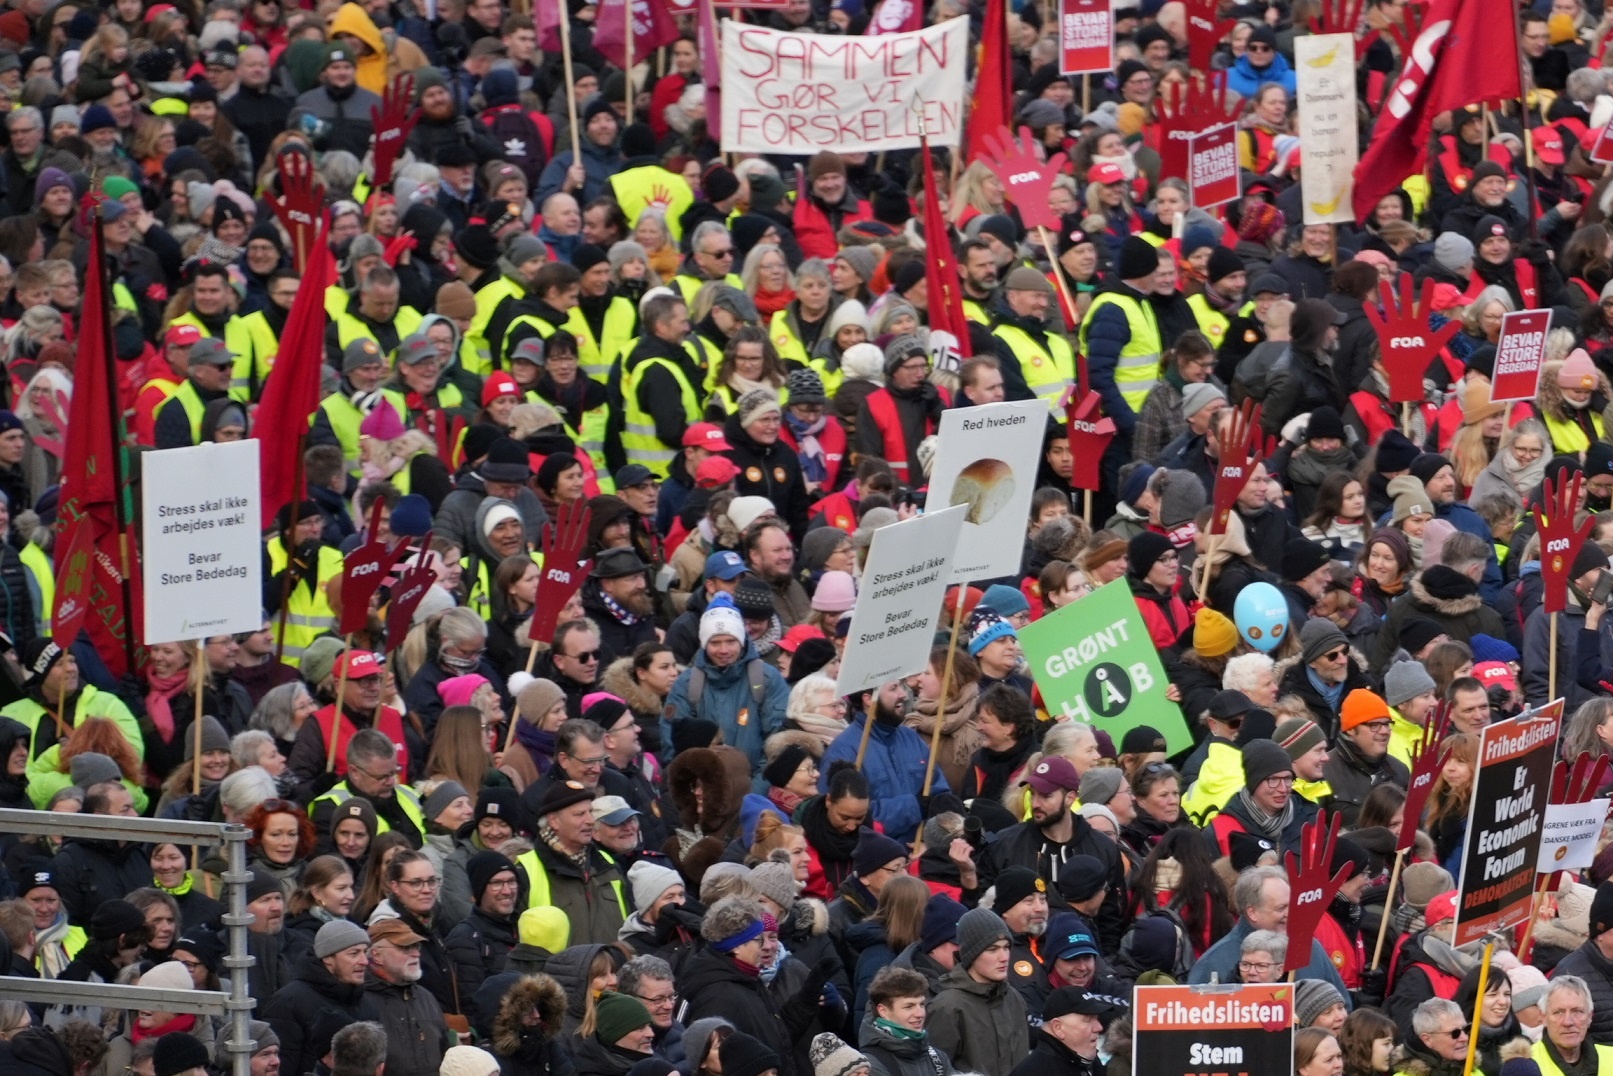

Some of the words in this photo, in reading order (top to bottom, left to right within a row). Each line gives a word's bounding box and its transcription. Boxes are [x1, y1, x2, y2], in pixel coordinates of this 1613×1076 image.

[1065, 12, 1107, 26] BEVAR
[1065, 24, 1107, 40] STORE
[739, 30, 950, 79] SAMMEN
[756, 80, 837, 109] GØR
[868, 79, 902, 102] VI
[738, 101, 958, 144] FORSKELLEN
[1194, 142, 1233, 163] BEVAR
[1194, 155, 1233, 176] STORE
[1009, 171, 1041, 185] FOA
[1391, 336, 1424, 348] FOA
[1502, 331, 1541, 349] BEVAR
[1501, 346, 1540, 363] STORE
[1498, 359, 1538, 375] BEDEDAG
[962, 419, 983, 431] Red
[986, 413, 1026, 430] hveden
[1222, 467, 1241, 478] FOA
[158, 503, 195, 518] Stress
[199, 500, 222, 515] skal
[225, 496, 248, 511] ikke
[162, 517, 213, 536] arbejdes
[217, 512, 245, 528] væk!
[1547, 539, 1569, 553] FOA
[188, 550, 221, 565] Bevar
[161, 569, 192, 585] Store
[196, 563, 247, 582] Bededag
[351, 560, 378, 577] FOA
[547, 568, 570, 584] FOA
[873, 569, 905, 586] Stress
[905, 562, 925, 577] skal
[926, 555, 945, 568] ikke
[872, 582, 914, 600] arbejdes
[915, 570, 939, 587] væk!
[884, 609, 913, 625] Bevar
[858, 629, 884, 645] Store
[887, 616, 929, 638] Bededag
[1045, 617, 1128, 678] GRØNT
[1061, 660, 1154, 724] HÅB
[1485, 721, 1556, 761] Frihedslisten
[1413, 773, 1431, 788] FOA
[1514, 766, 1528, 790] Er
[1495, 785, 1535, 822] World
[1478, 813, 1538, 854] Economic
[1543, 822, 1569, 830] NGRENE
[1484, 848, 1526, 880] Forum
[1297, 888, 1322, 905] FOA
[1146, 1002, 1285, 1024] Frihedslisten
[1189, 1043, 1243, 1064] Stem
